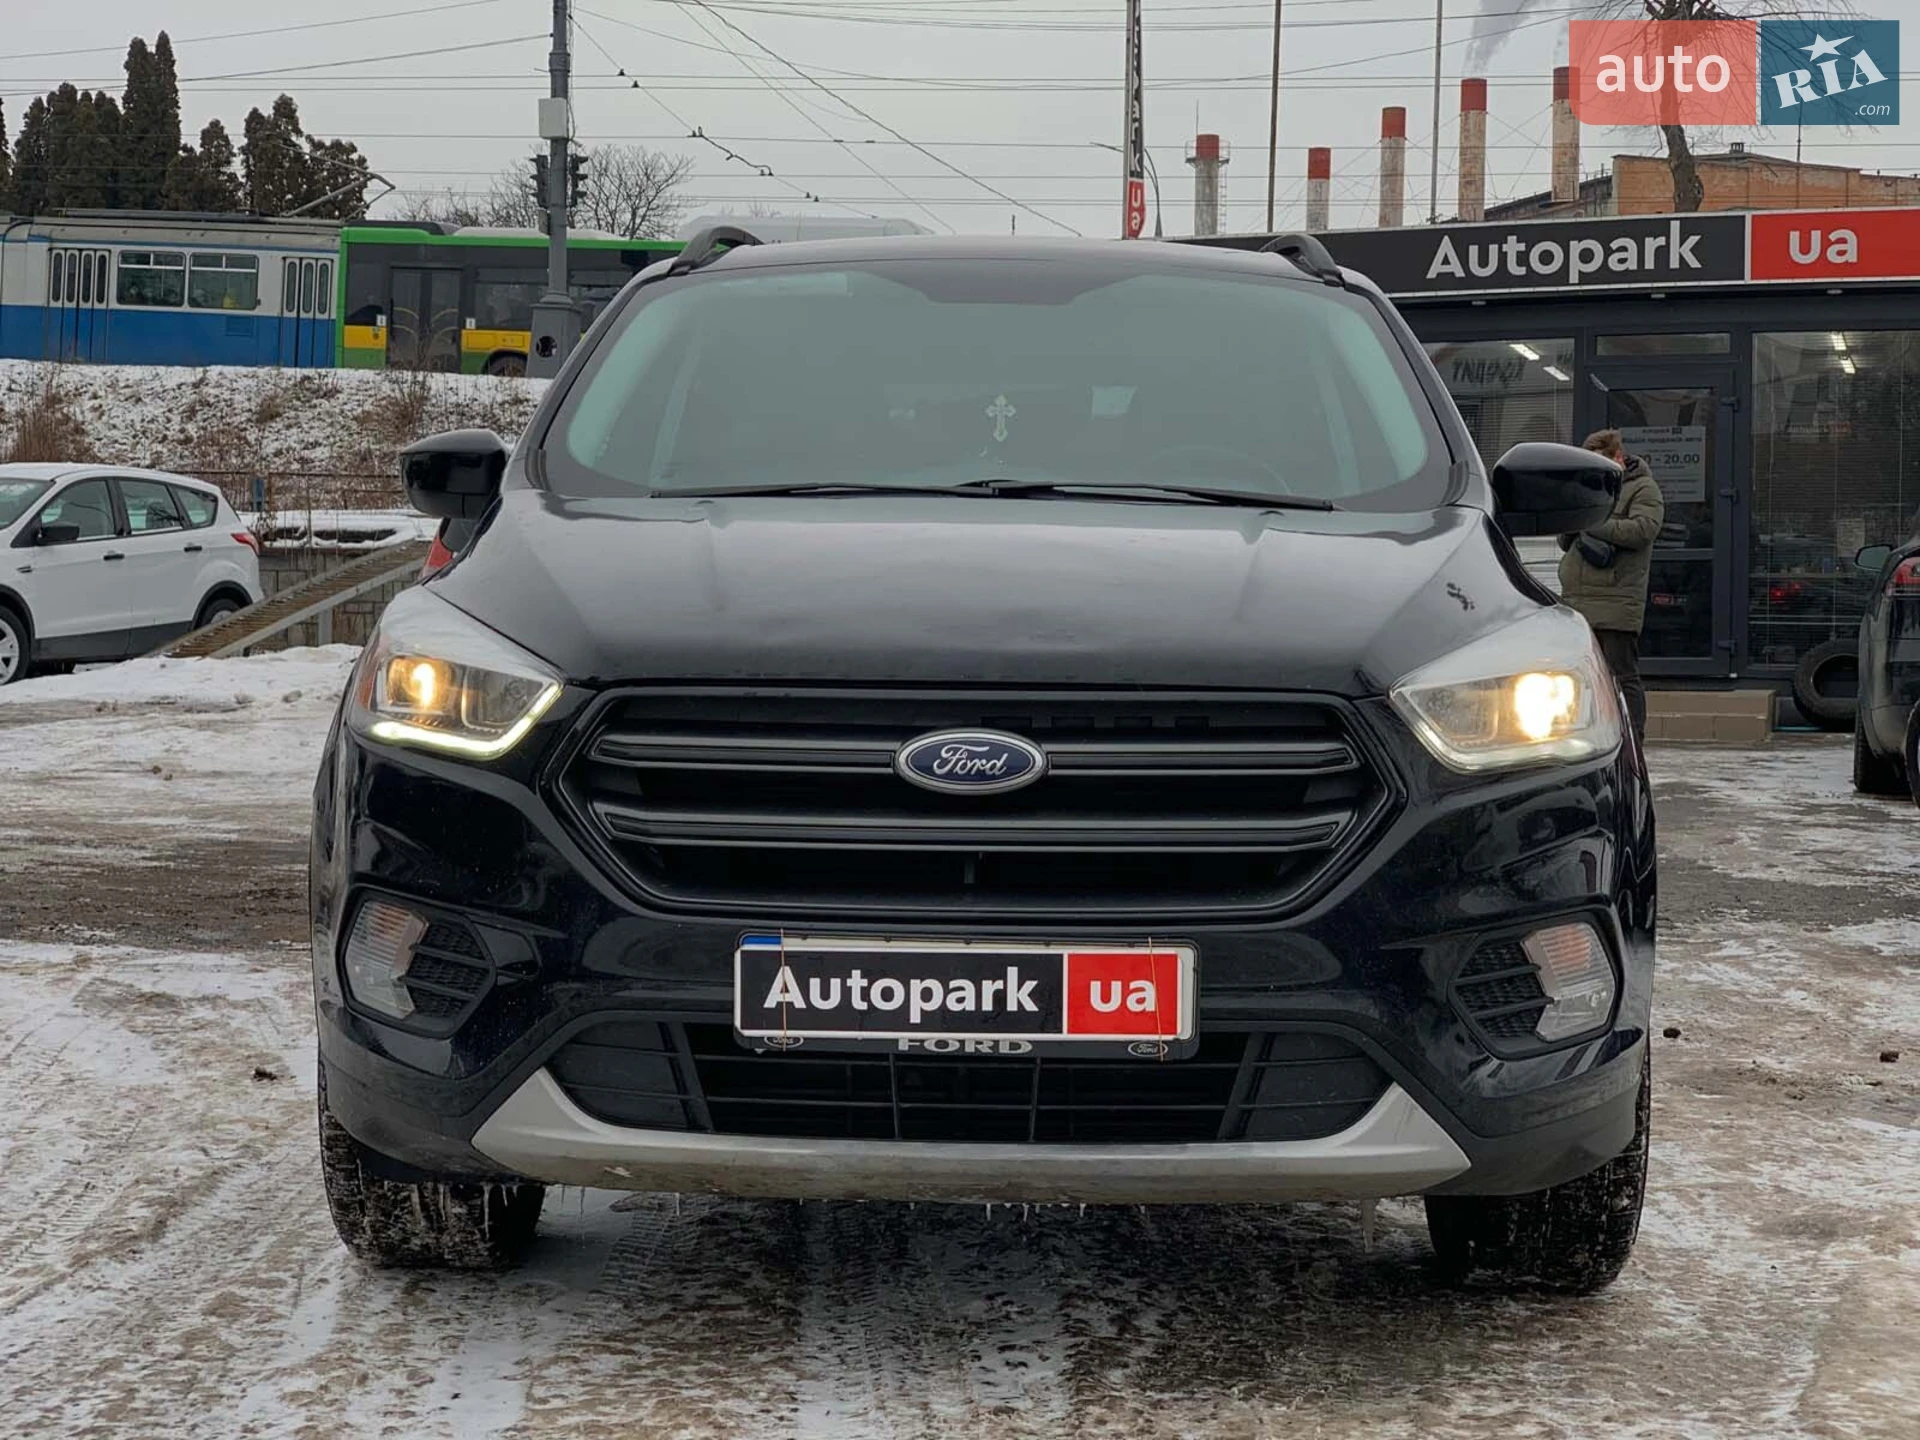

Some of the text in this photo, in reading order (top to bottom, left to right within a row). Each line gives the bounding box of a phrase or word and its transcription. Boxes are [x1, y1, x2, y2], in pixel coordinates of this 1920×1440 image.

[1426, 220, 1859, 284] Autopark ua
[1663, 453, 1700, 465] 20.00
[933, 743, 1009, 776] Ford
[763, 965, 1157, 1023] Autopark ua
[898, 1037, 1033, 1055] FORD
